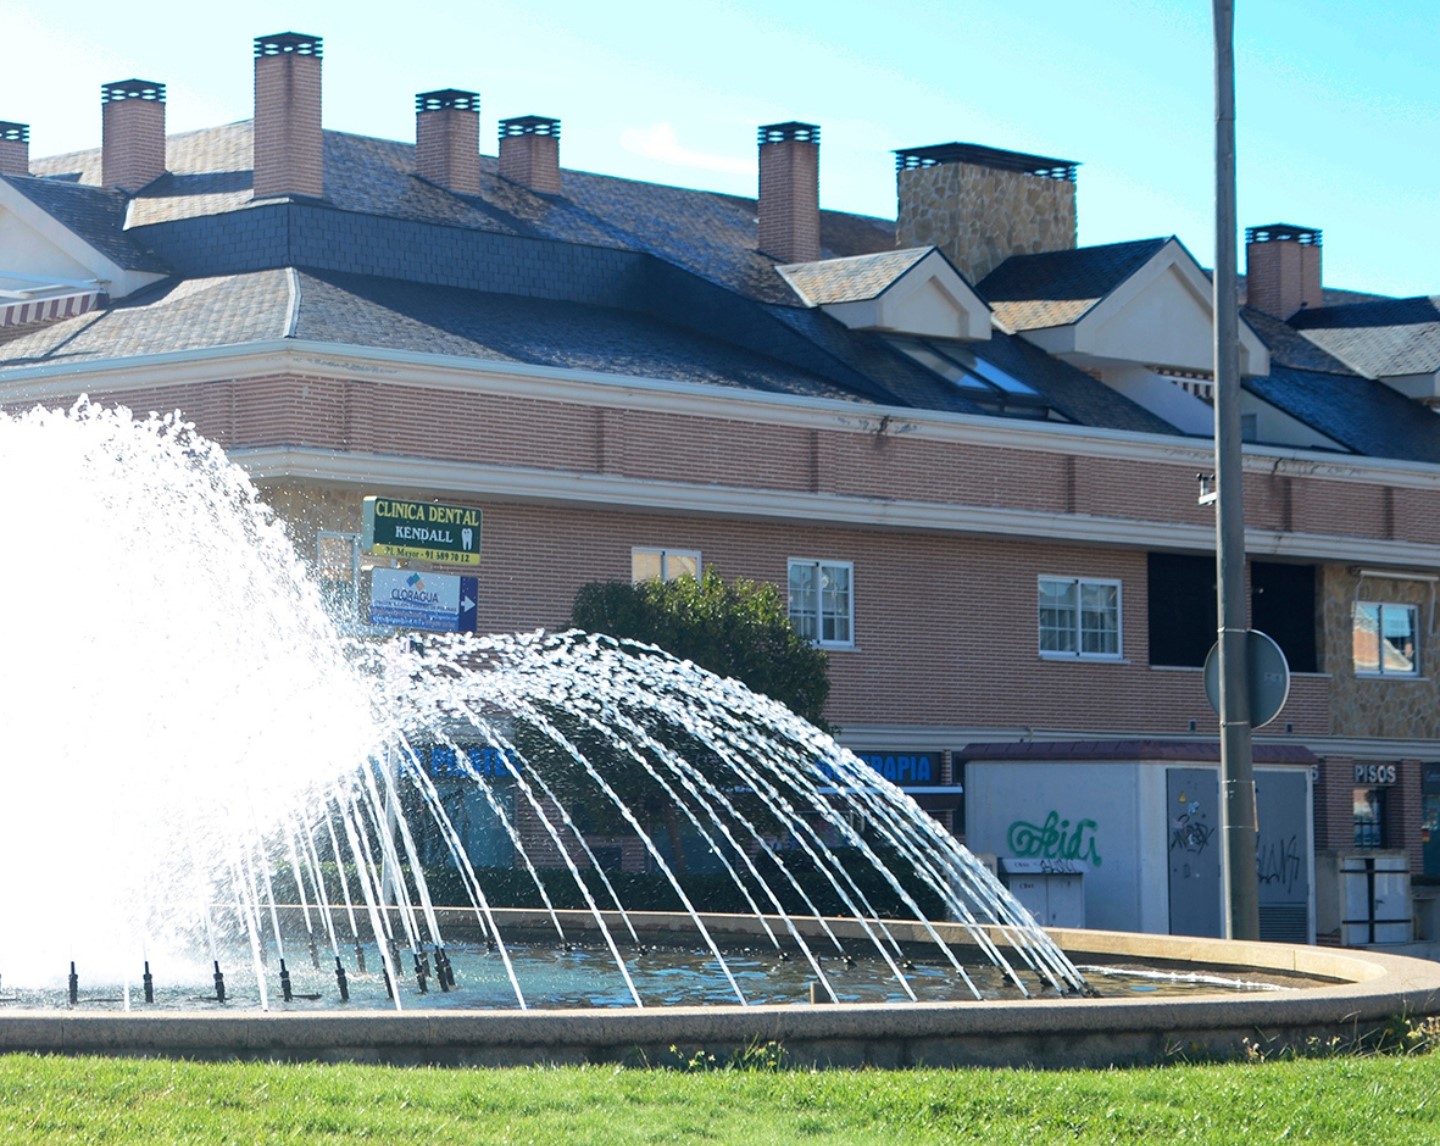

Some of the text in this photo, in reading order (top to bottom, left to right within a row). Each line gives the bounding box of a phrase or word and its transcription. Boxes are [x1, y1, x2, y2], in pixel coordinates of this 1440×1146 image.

[375, 500, 479, 526] CLINICA DENTAL
[395, 525, 453, 543] KENDALL
[461, 553, 470, 563] 12
[1355, 764, 1397, 783] PISOS
